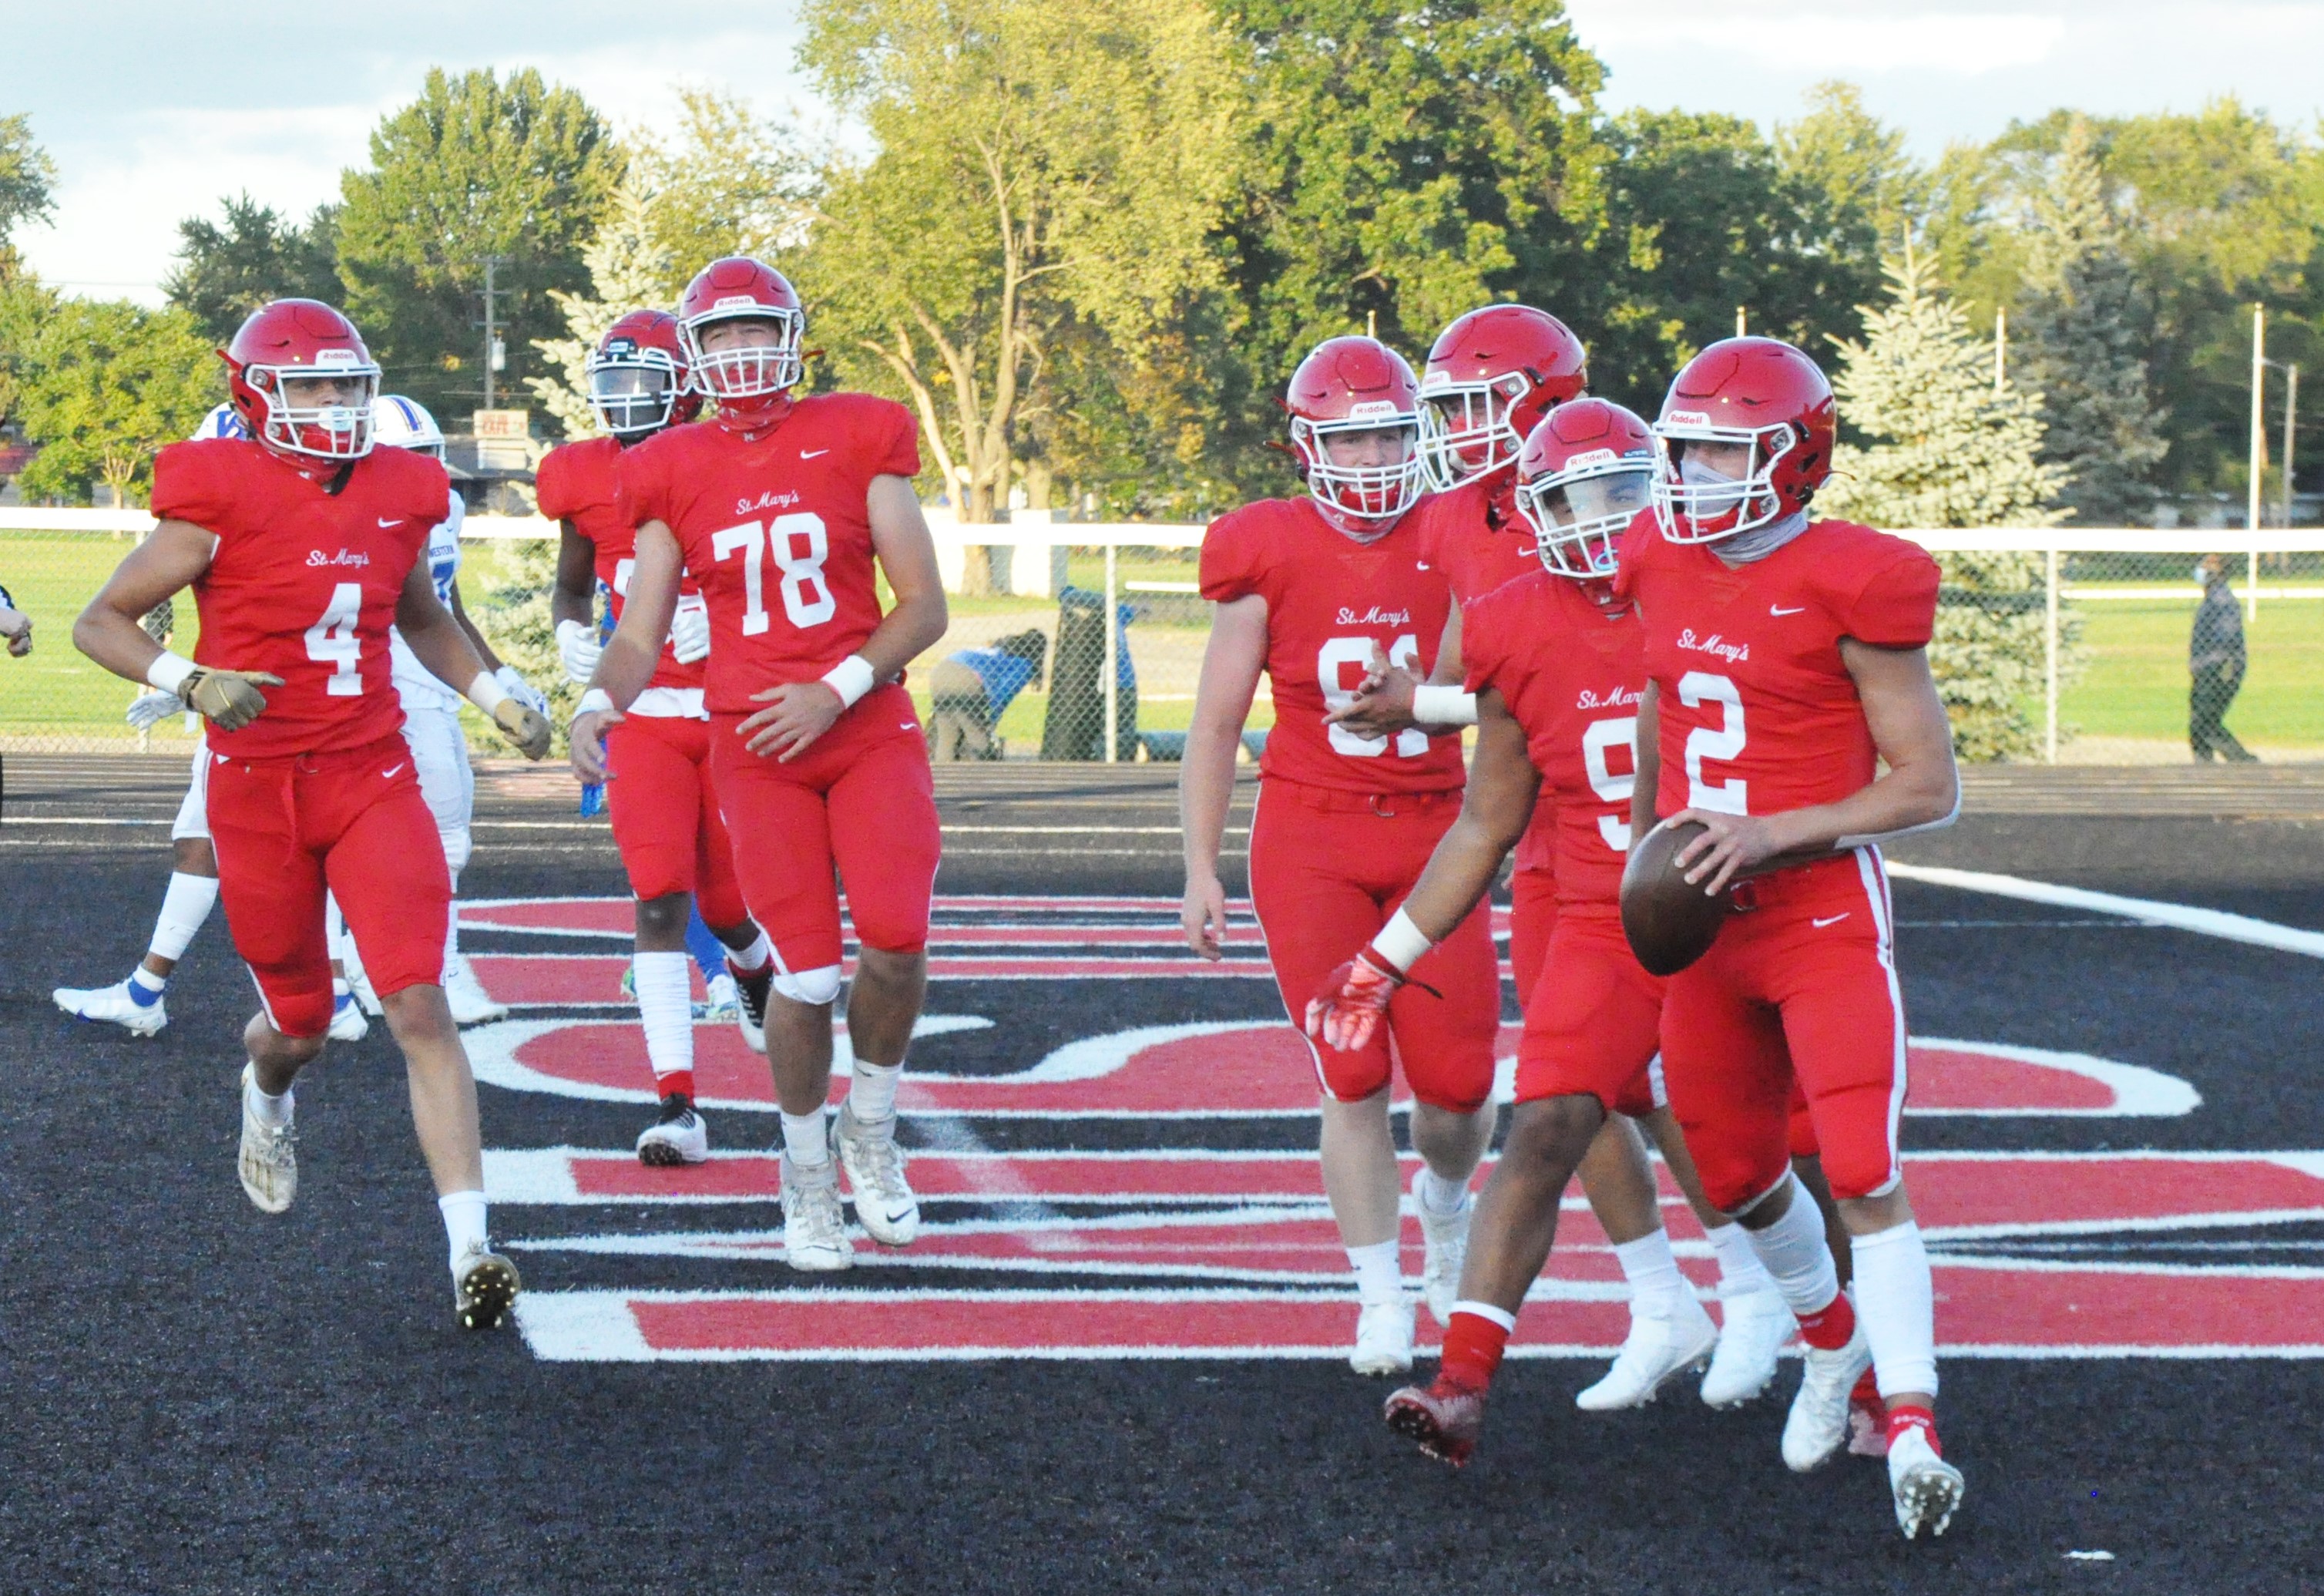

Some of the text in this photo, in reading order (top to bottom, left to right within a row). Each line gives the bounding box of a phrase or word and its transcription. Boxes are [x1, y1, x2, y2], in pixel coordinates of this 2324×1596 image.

[718, 296, 751, 308] Riddell
[1356, 405, 1392, 414] Riddell
[1671, 414, 1703, 425] Riddell
[1570, 452, 1610, 466] Riddell
[736, 490, 800, 515] St. Mary's
[306, 549, 370, 567] St. Mary's
[712, 512, 838, 637] 78
[1335, 607, 1410, 628] St. Mary's
[304, 583, 363, 696] 4
[1678, 629, 1749, 663] St. Mary's
[1577, 689, 1600, 709] St.
[1678, 671, 1748, 815] 2
